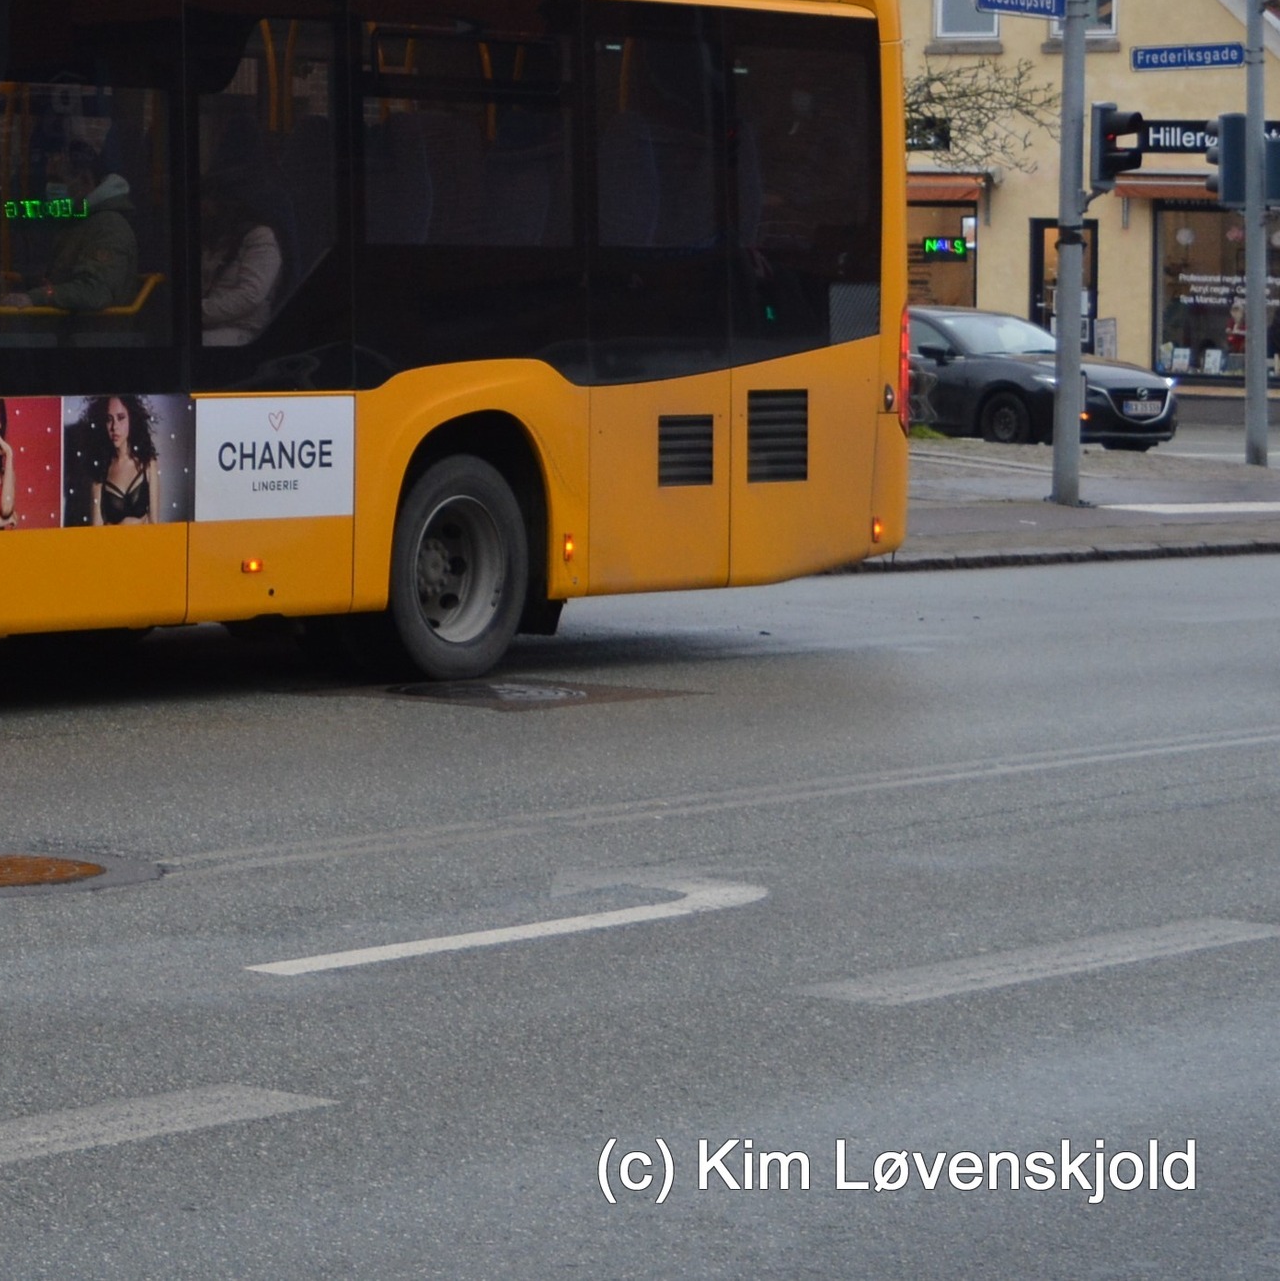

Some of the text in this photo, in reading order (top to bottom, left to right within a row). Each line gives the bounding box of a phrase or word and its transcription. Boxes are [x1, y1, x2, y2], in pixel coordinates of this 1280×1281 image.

[1137, 48, 1239, 66] Frederiksgade
[1148, 126, 1218, 148] Hillerø
[925, 239, 963, 254] NAILS
[218, 439, 333, 472] CHANGE
[252, 479, 299, 492] LINGERIE
